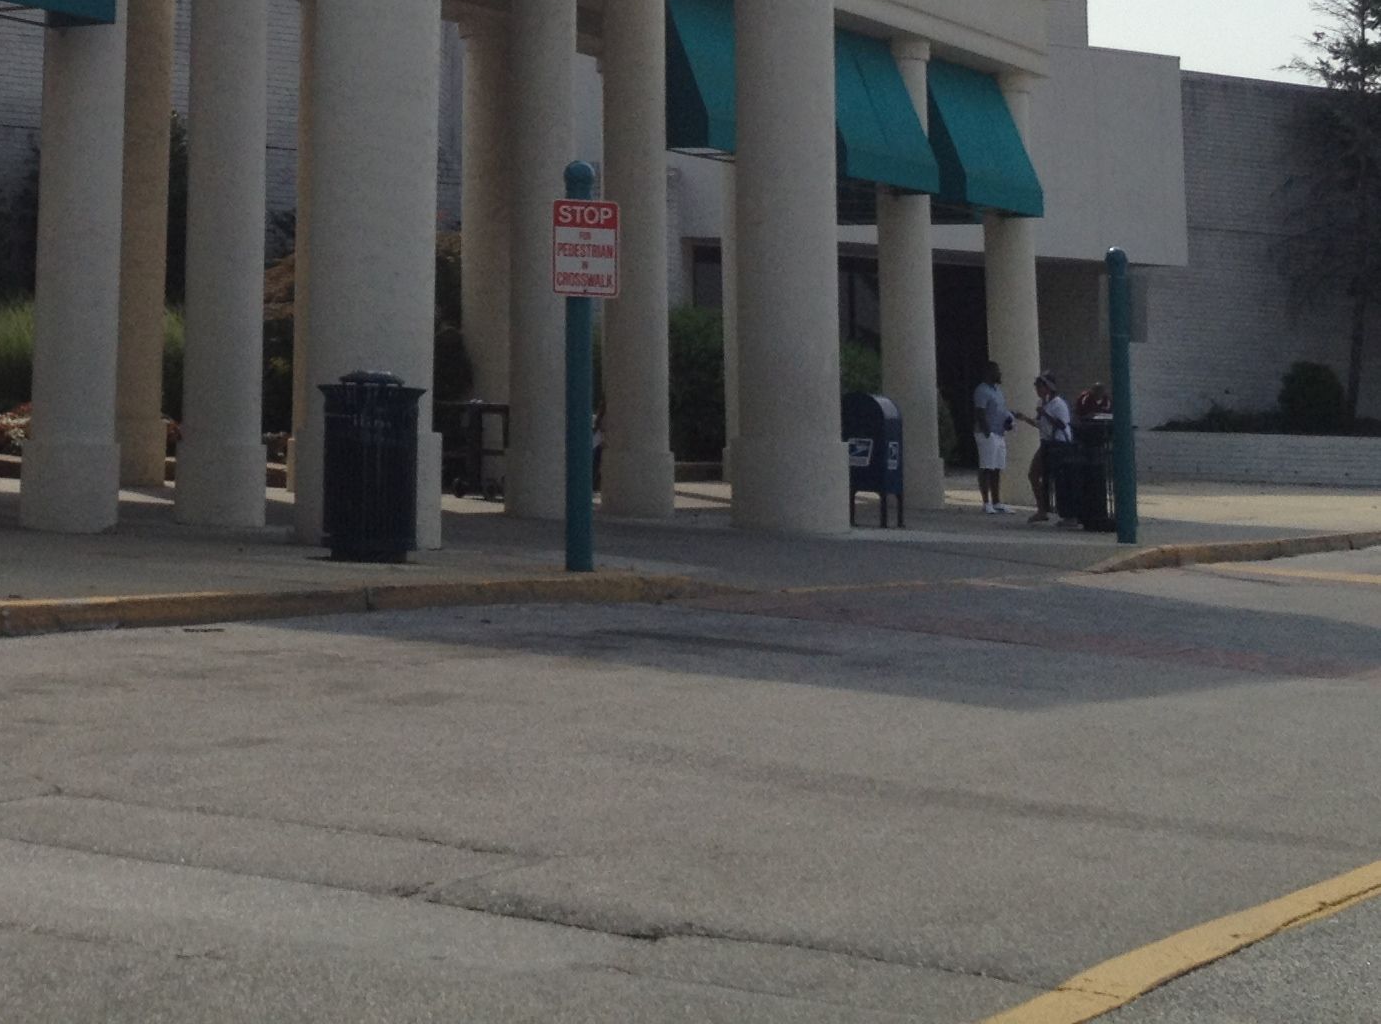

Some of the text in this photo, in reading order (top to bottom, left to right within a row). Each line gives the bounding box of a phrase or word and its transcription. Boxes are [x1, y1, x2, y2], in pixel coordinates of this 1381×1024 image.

[558, 205, 612, 224] STOP
[556, 243, 614, 258] PEDESTRIAN
[556, 272, 613, 287] CROSSWALK
